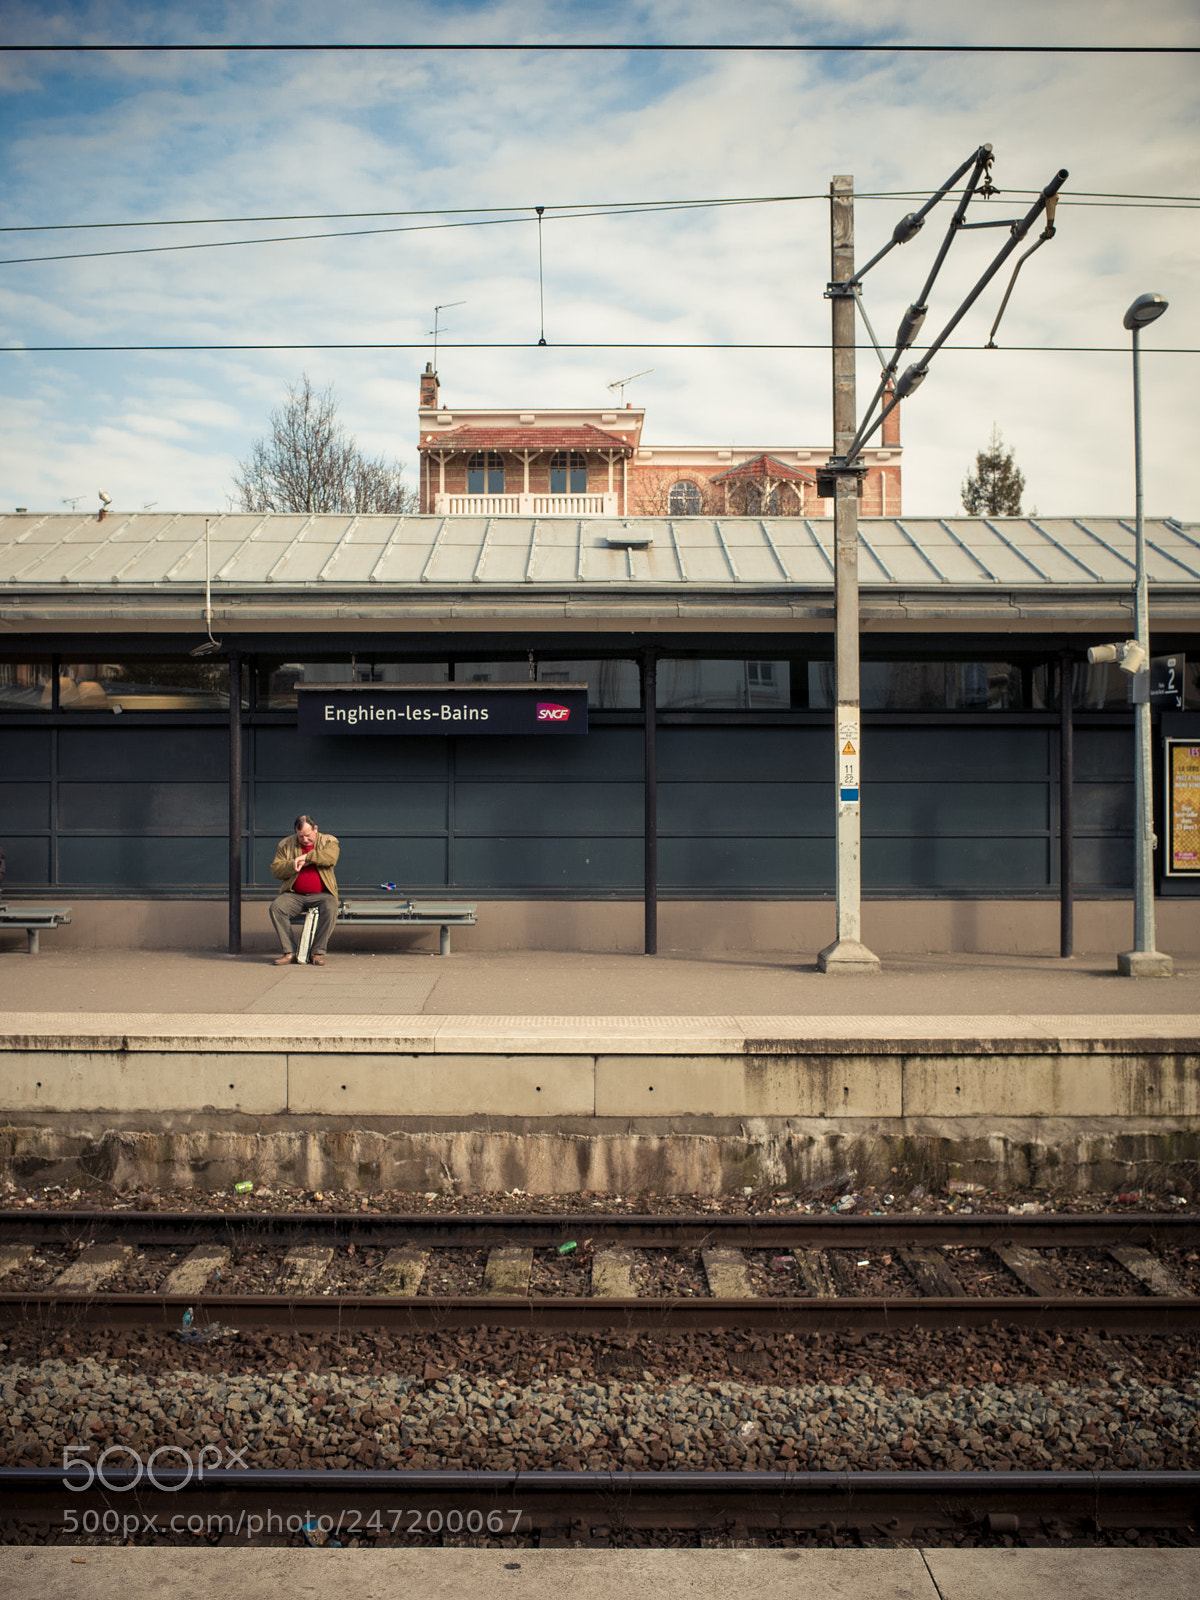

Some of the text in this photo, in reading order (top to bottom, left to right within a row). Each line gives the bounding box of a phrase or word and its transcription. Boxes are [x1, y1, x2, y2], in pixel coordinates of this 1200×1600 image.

[1168, 668, 1175, 690] 2
[323, 704, 489, 724] Enghien-les-Bains
[538, 709, 569, 719] SNCF
[845, 764, 853, 774] 11
[844, 775, 854, 783] 22
